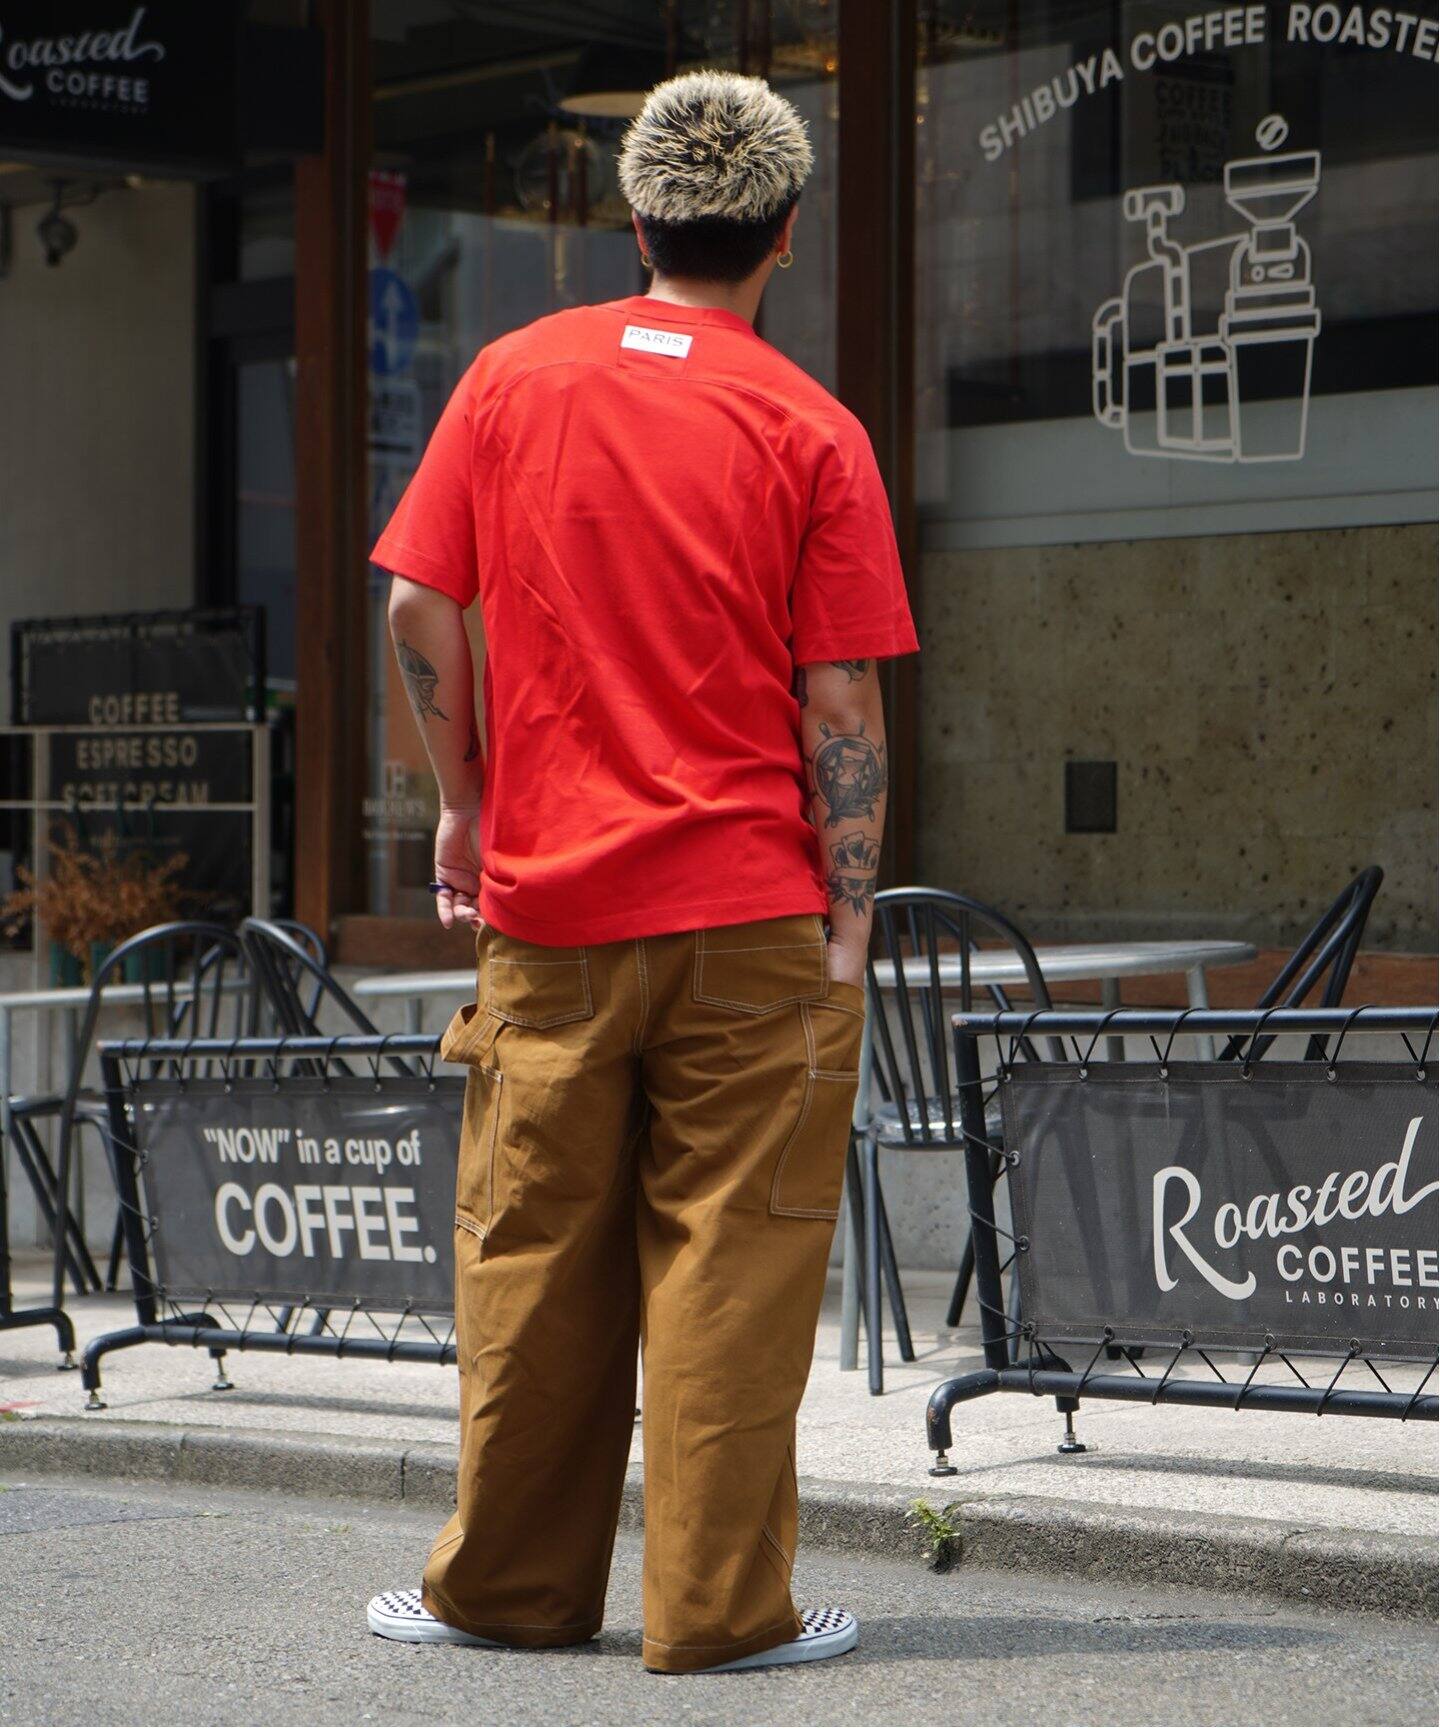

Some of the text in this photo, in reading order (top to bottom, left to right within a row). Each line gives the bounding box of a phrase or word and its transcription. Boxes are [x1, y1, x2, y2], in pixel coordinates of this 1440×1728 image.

[46, 68, 150, 103] COFFEE
[979, 47, 1124, 161] SHIBUYA
[1130, 5, 1266, 71] COFFEE
[1287, 4, 1438, 63] ROASTE
[629, 329, 684, 346] PARIS
[88, 691, 180, 724] COFFEE
[75, 735, 199, 769] ESPRESSO
[295, 1130, 320, 1164] in
[324, 1138, 341, 1164] a
[345, 1137, 392, 1175] cup
[396, 1130, 421, 1166] of
[215, 1182, 437, 1264] COFFEE.
[1153, 1116, 1439, 1301] Roasted
[1276, 1244, 1439, 1287] COFFEE
